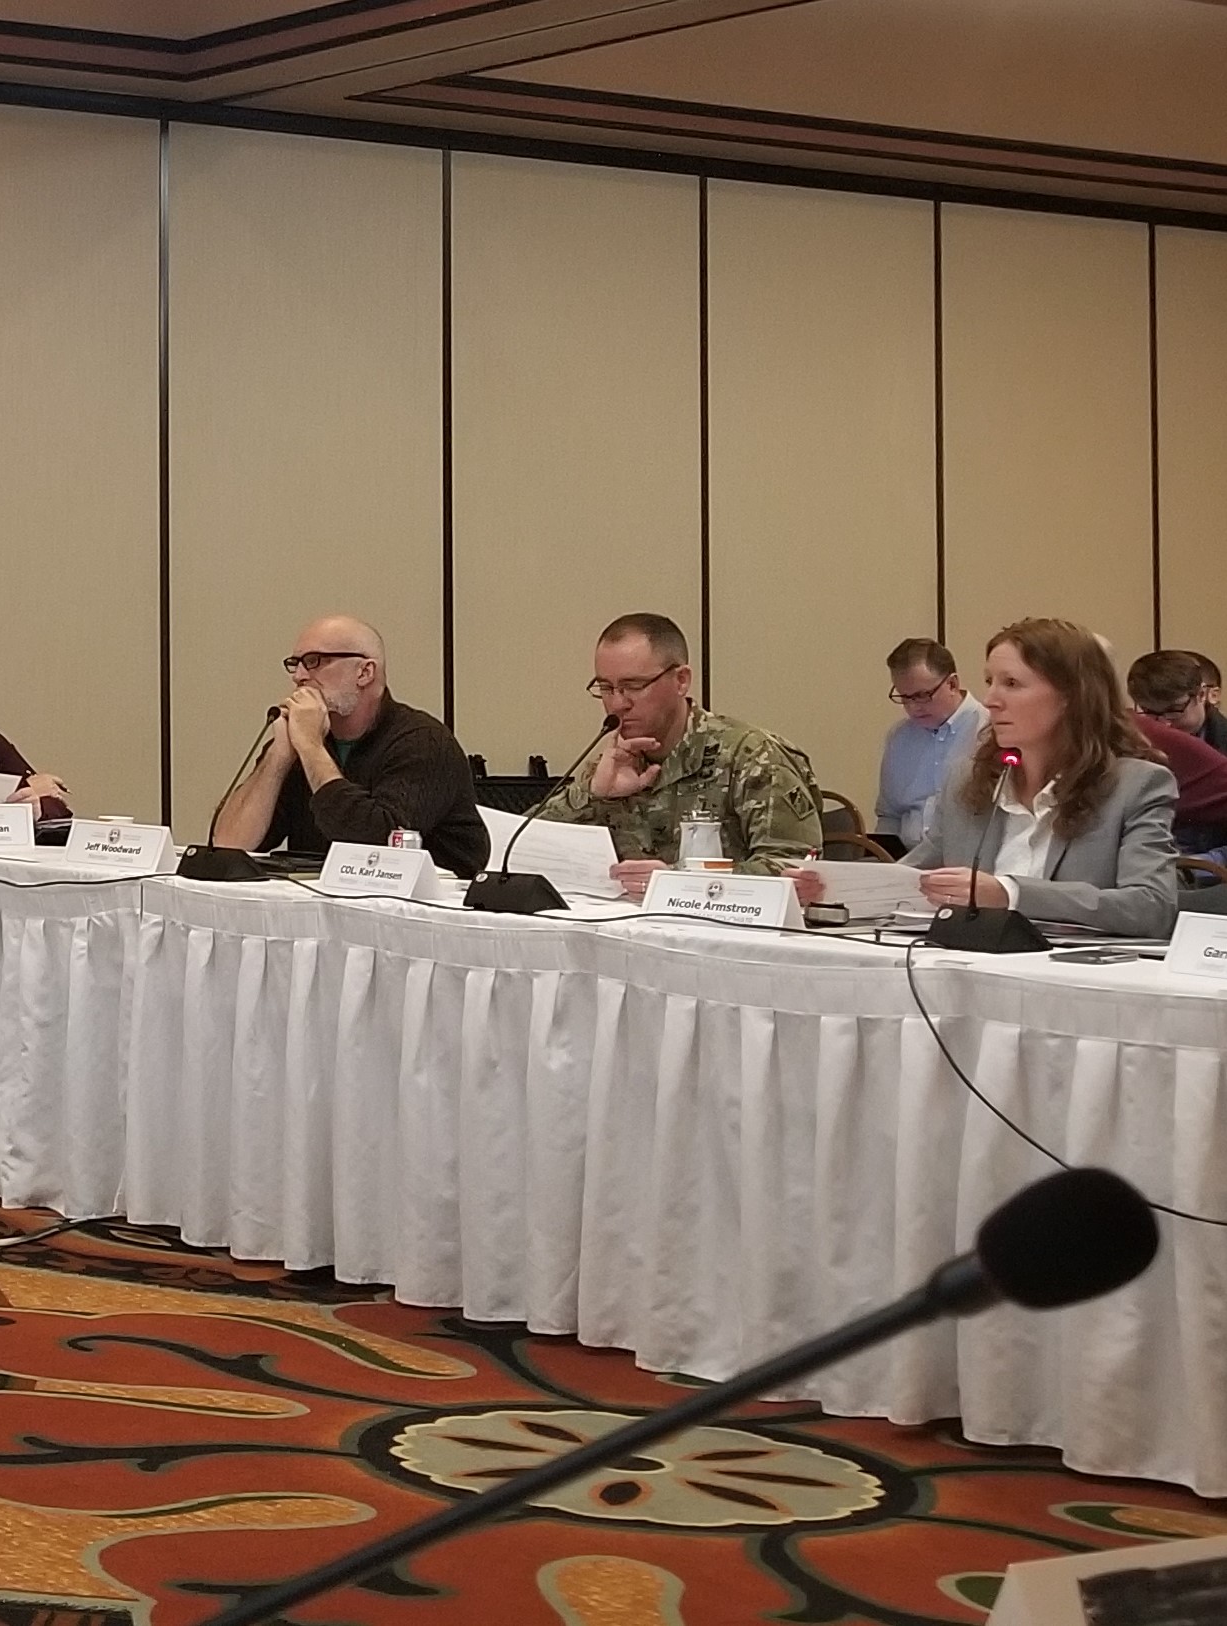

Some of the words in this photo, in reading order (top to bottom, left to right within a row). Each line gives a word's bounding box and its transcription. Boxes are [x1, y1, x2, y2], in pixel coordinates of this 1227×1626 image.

[85, 842, 100, 850] Jeff
[101, 844, 142, 855] Woodward
[358, 867, 375, 877] Karl
[375, 868, 403, 880] Jansen
[667, 898, 701, 910] Nicole
[703, 901, 762, 917] Armstrong
